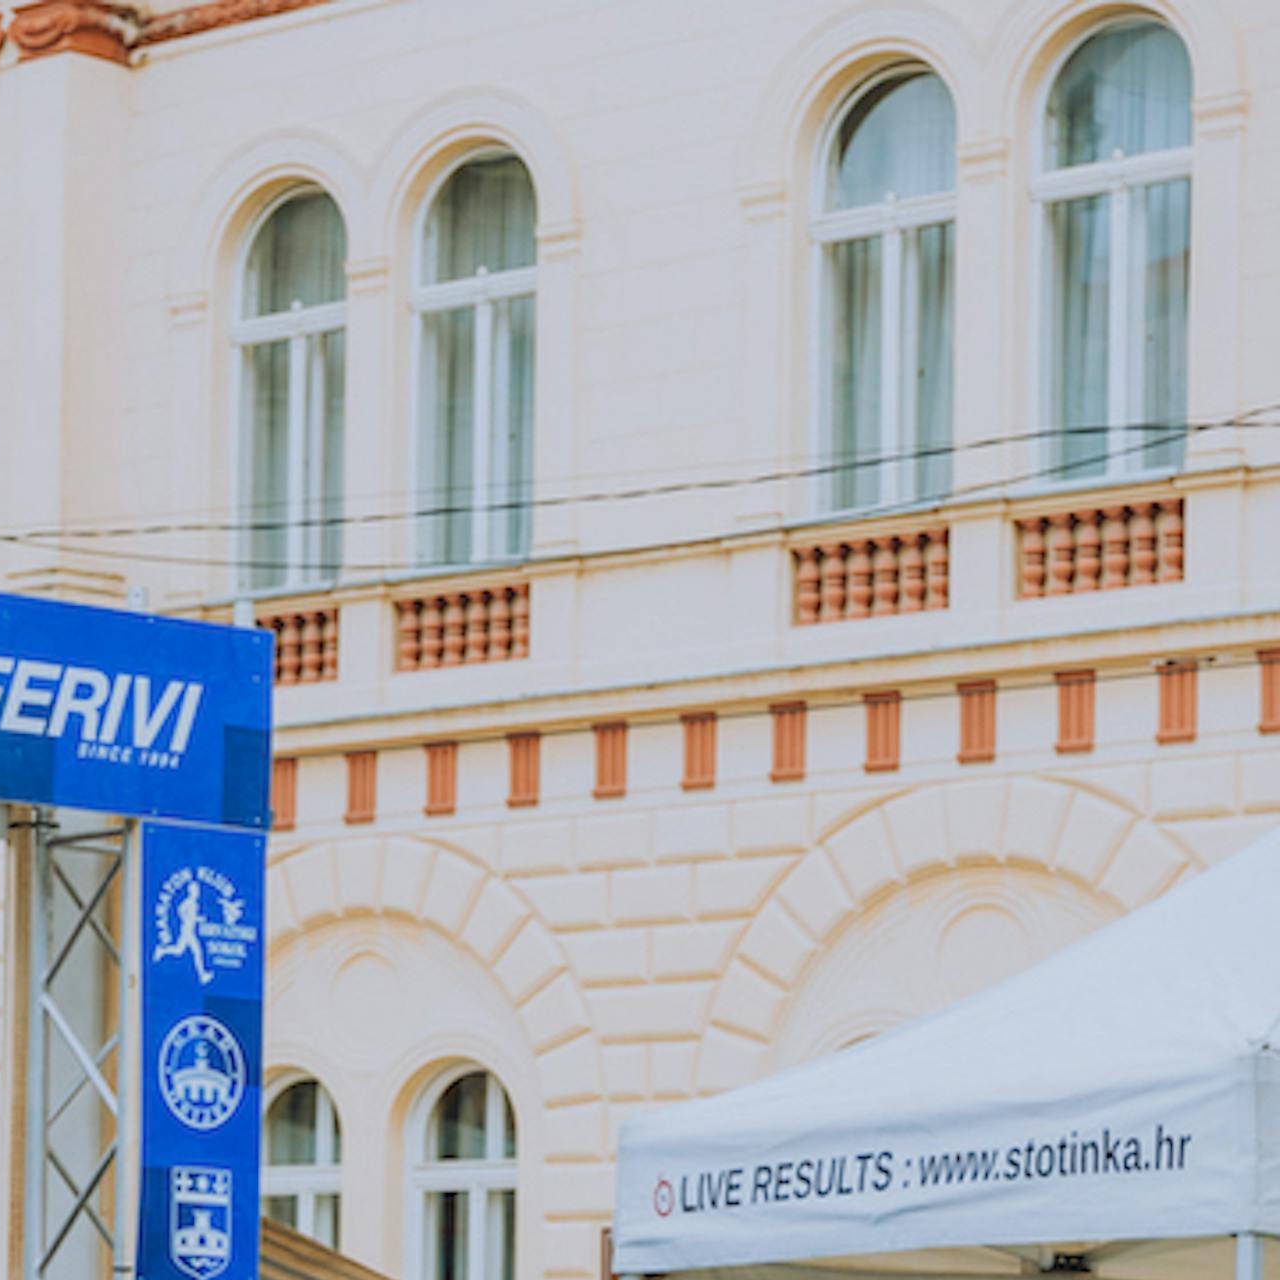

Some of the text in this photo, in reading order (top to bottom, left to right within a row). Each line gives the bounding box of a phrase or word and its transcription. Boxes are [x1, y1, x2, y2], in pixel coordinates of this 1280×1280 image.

[681, 1168, 744, 1213] LIVE
[750, 1150, 894, 1205] RESULTS
[919, 1124, 1193, 1186] www.stotinka.hr
